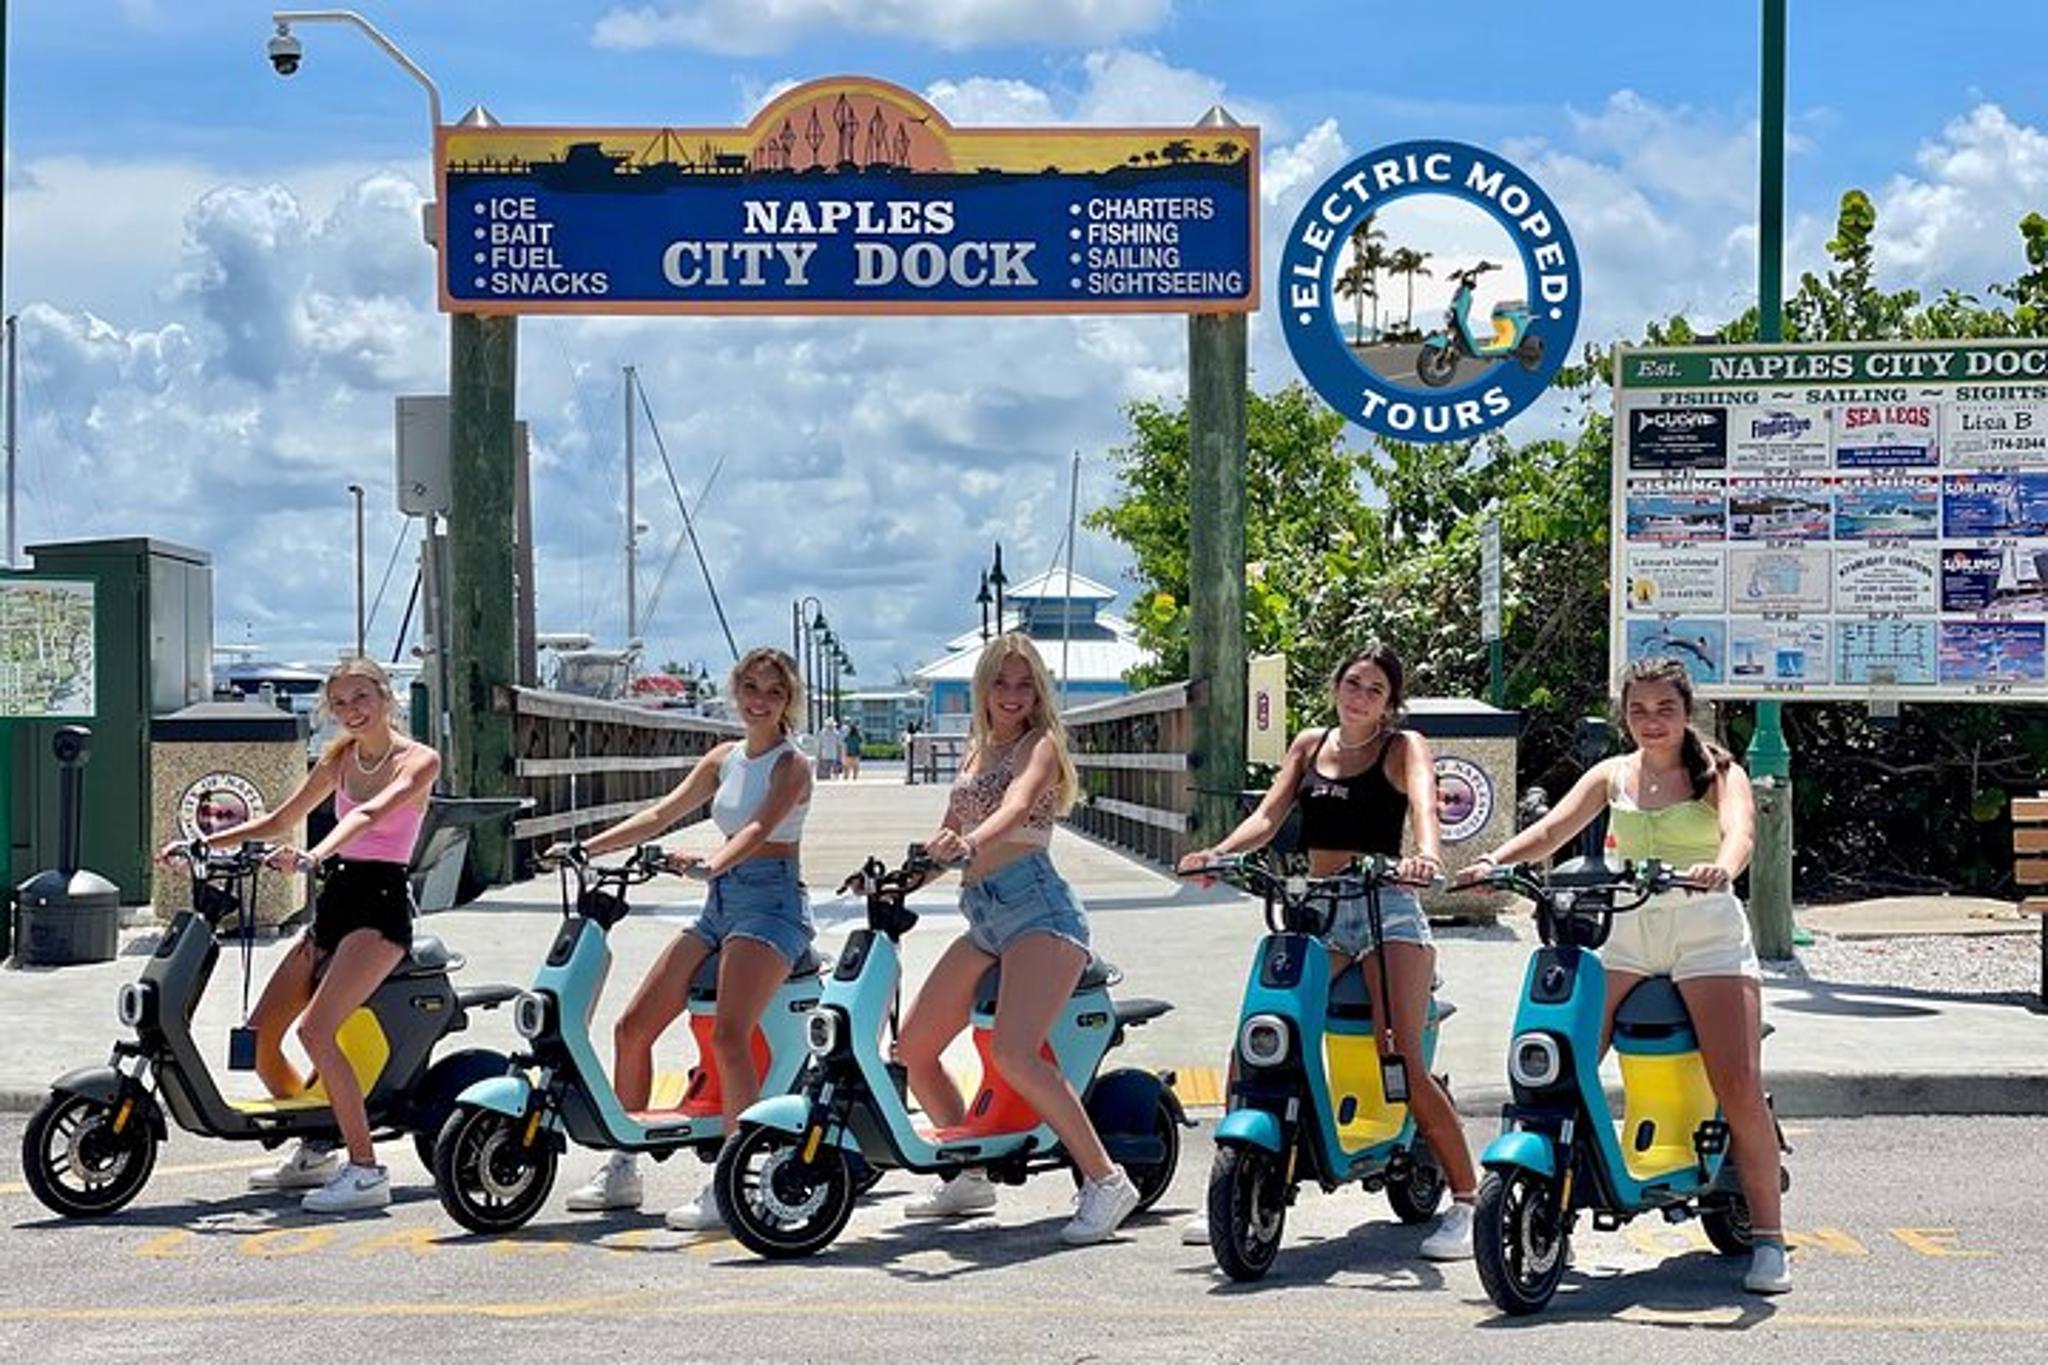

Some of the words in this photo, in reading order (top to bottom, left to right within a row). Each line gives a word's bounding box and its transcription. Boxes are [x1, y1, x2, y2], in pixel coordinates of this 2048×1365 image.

[491, 198, 536, 220] ICE
[743, 201, 954, 233] NAPLES
[1088, 198, 1214, 220] CHARTERS
[491, 223, 554, 245] BAIT
[1088, 222, 1179, 245] FISHING
[491, 247, 563, 269] FUEL
[663, 242, 818, 286] CITY
[854, 242, 1038, 286] DOCK
[1088, 247, 1180, 269] SAILING
[491, 272, 609, 294] SNACKS
[1088, 272, 1242, 294] SIGHTSEEING
[1637, 360, 1681, 377] Est.
[1709, 354, 1854, 380] NAPLES
[1865, 352, 1955, 377] CITY
[1660, 391, 1759, 405] FISHING
[1806, 388, 1907, 404] SAILING
[1846, 406, 1881, 429] SEA
[1886, 406, 1930, 427] LEGS
[2014, 411, 2033, 431] B
